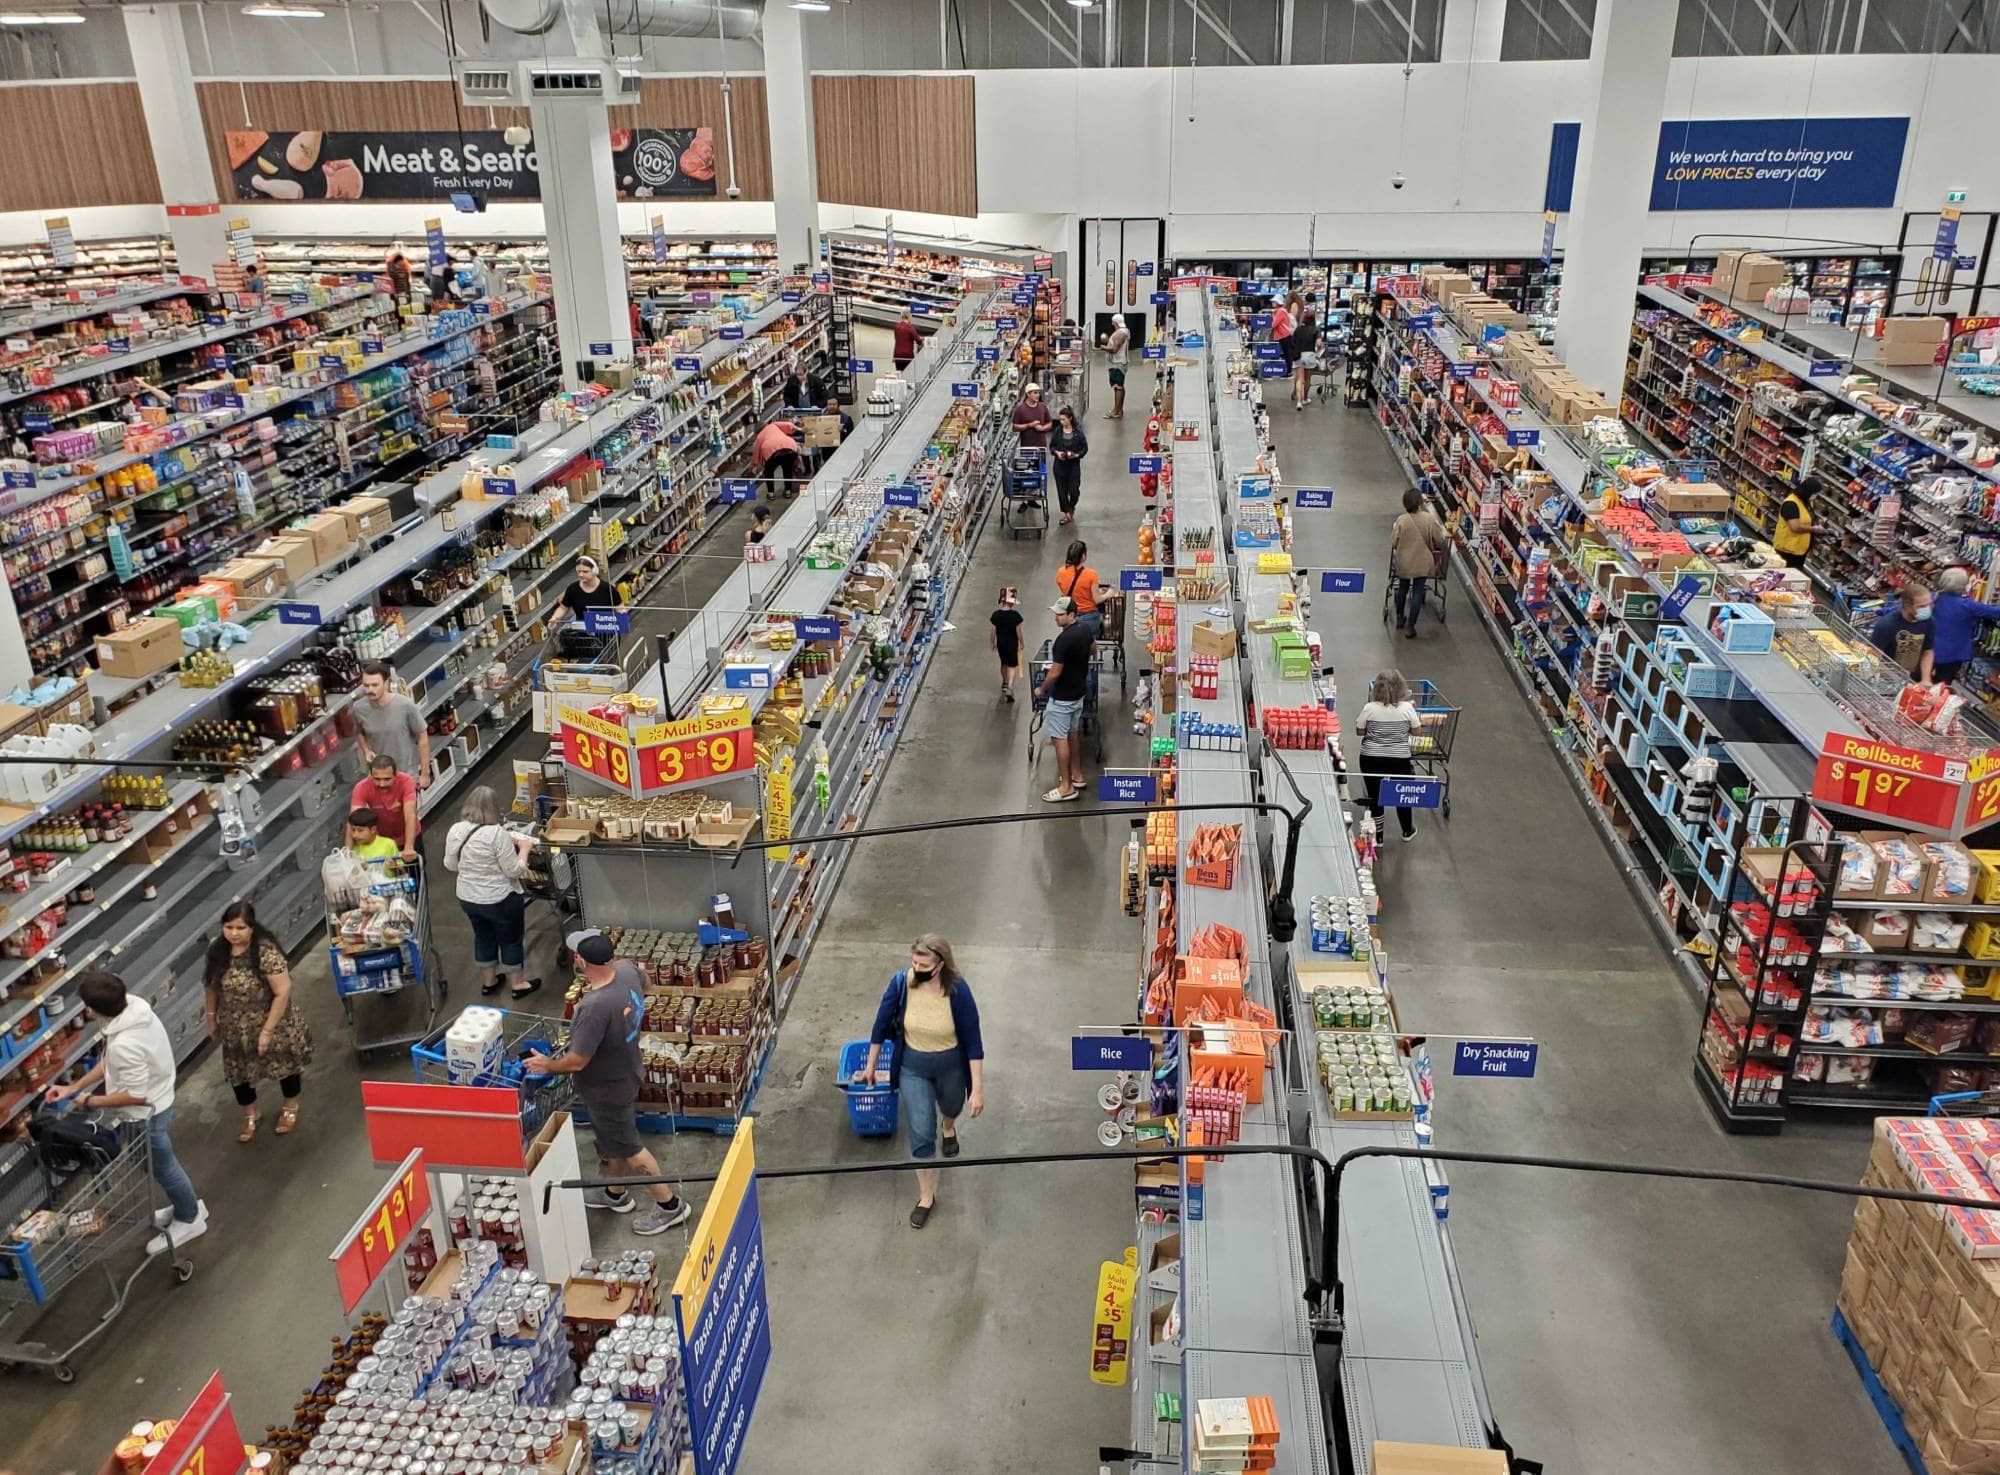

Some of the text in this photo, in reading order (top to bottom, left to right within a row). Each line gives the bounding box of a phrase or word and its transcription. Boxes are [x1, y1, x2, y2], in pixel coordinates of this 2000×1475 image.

[363, 143, 436, 173] Meat
[439, 147, 462, 173] &
[1669, 148, 1853, 165] We work hard to bring you
[638, 151, 672, 175] 100%
[1665, 166, 1826, 182] LOW PRICES every day
[433, 176, 461, 188] Fresh
[493, 176, 514, 190] Day
[889, 493, 899, 501] Dry
[1305, 492, 1323, 500] Baking
[1135, 572, 1148, 580] Side
[1132, 580, 1150, 588] Dishes
[1335, 578, 1351, 587] Flour
[288, 610, 312, 620] Vinegar
[595, 622, 620, 631] Noodles
[805, 625, 831, 634] Mexican
[573, 713, 623, 742] Multi Save
[664, 716, 739, 739] Multi Save
[575, 732, 594, 770] 3
[658, 746, 685, 783] 3
[684, 751, 695, 761] for
[1113, 778, 1142, 788] Instant
[1395, 783, 1427, 794] Canned
[772, 790, 781, 801] 4
[1119, 788, 1136, 798] Rice
[1399, 794, 1419, 804] Fruit
[1100, 1047, 1122, 1059] Rice
[1463, 1046, 1530, 1062] Dry Snacking
[1482, 1060, 1507, 1072] Fruit
[700, 1237, 715, 1282] 06
[1107, 1273, 1128, 1285] Multi
[1107, 1281, 1126, 1293] Save
[1103, 1291, 1116, 1307] 4
[694, 1245, 738, 1366] Pasta & Sauce
[702, 1243, 759, 1408] Canned Fish & Meat
[705, 1299, 760, 1462] Canned Vegetables
[724, 1402, 746, 1458] Dishes
